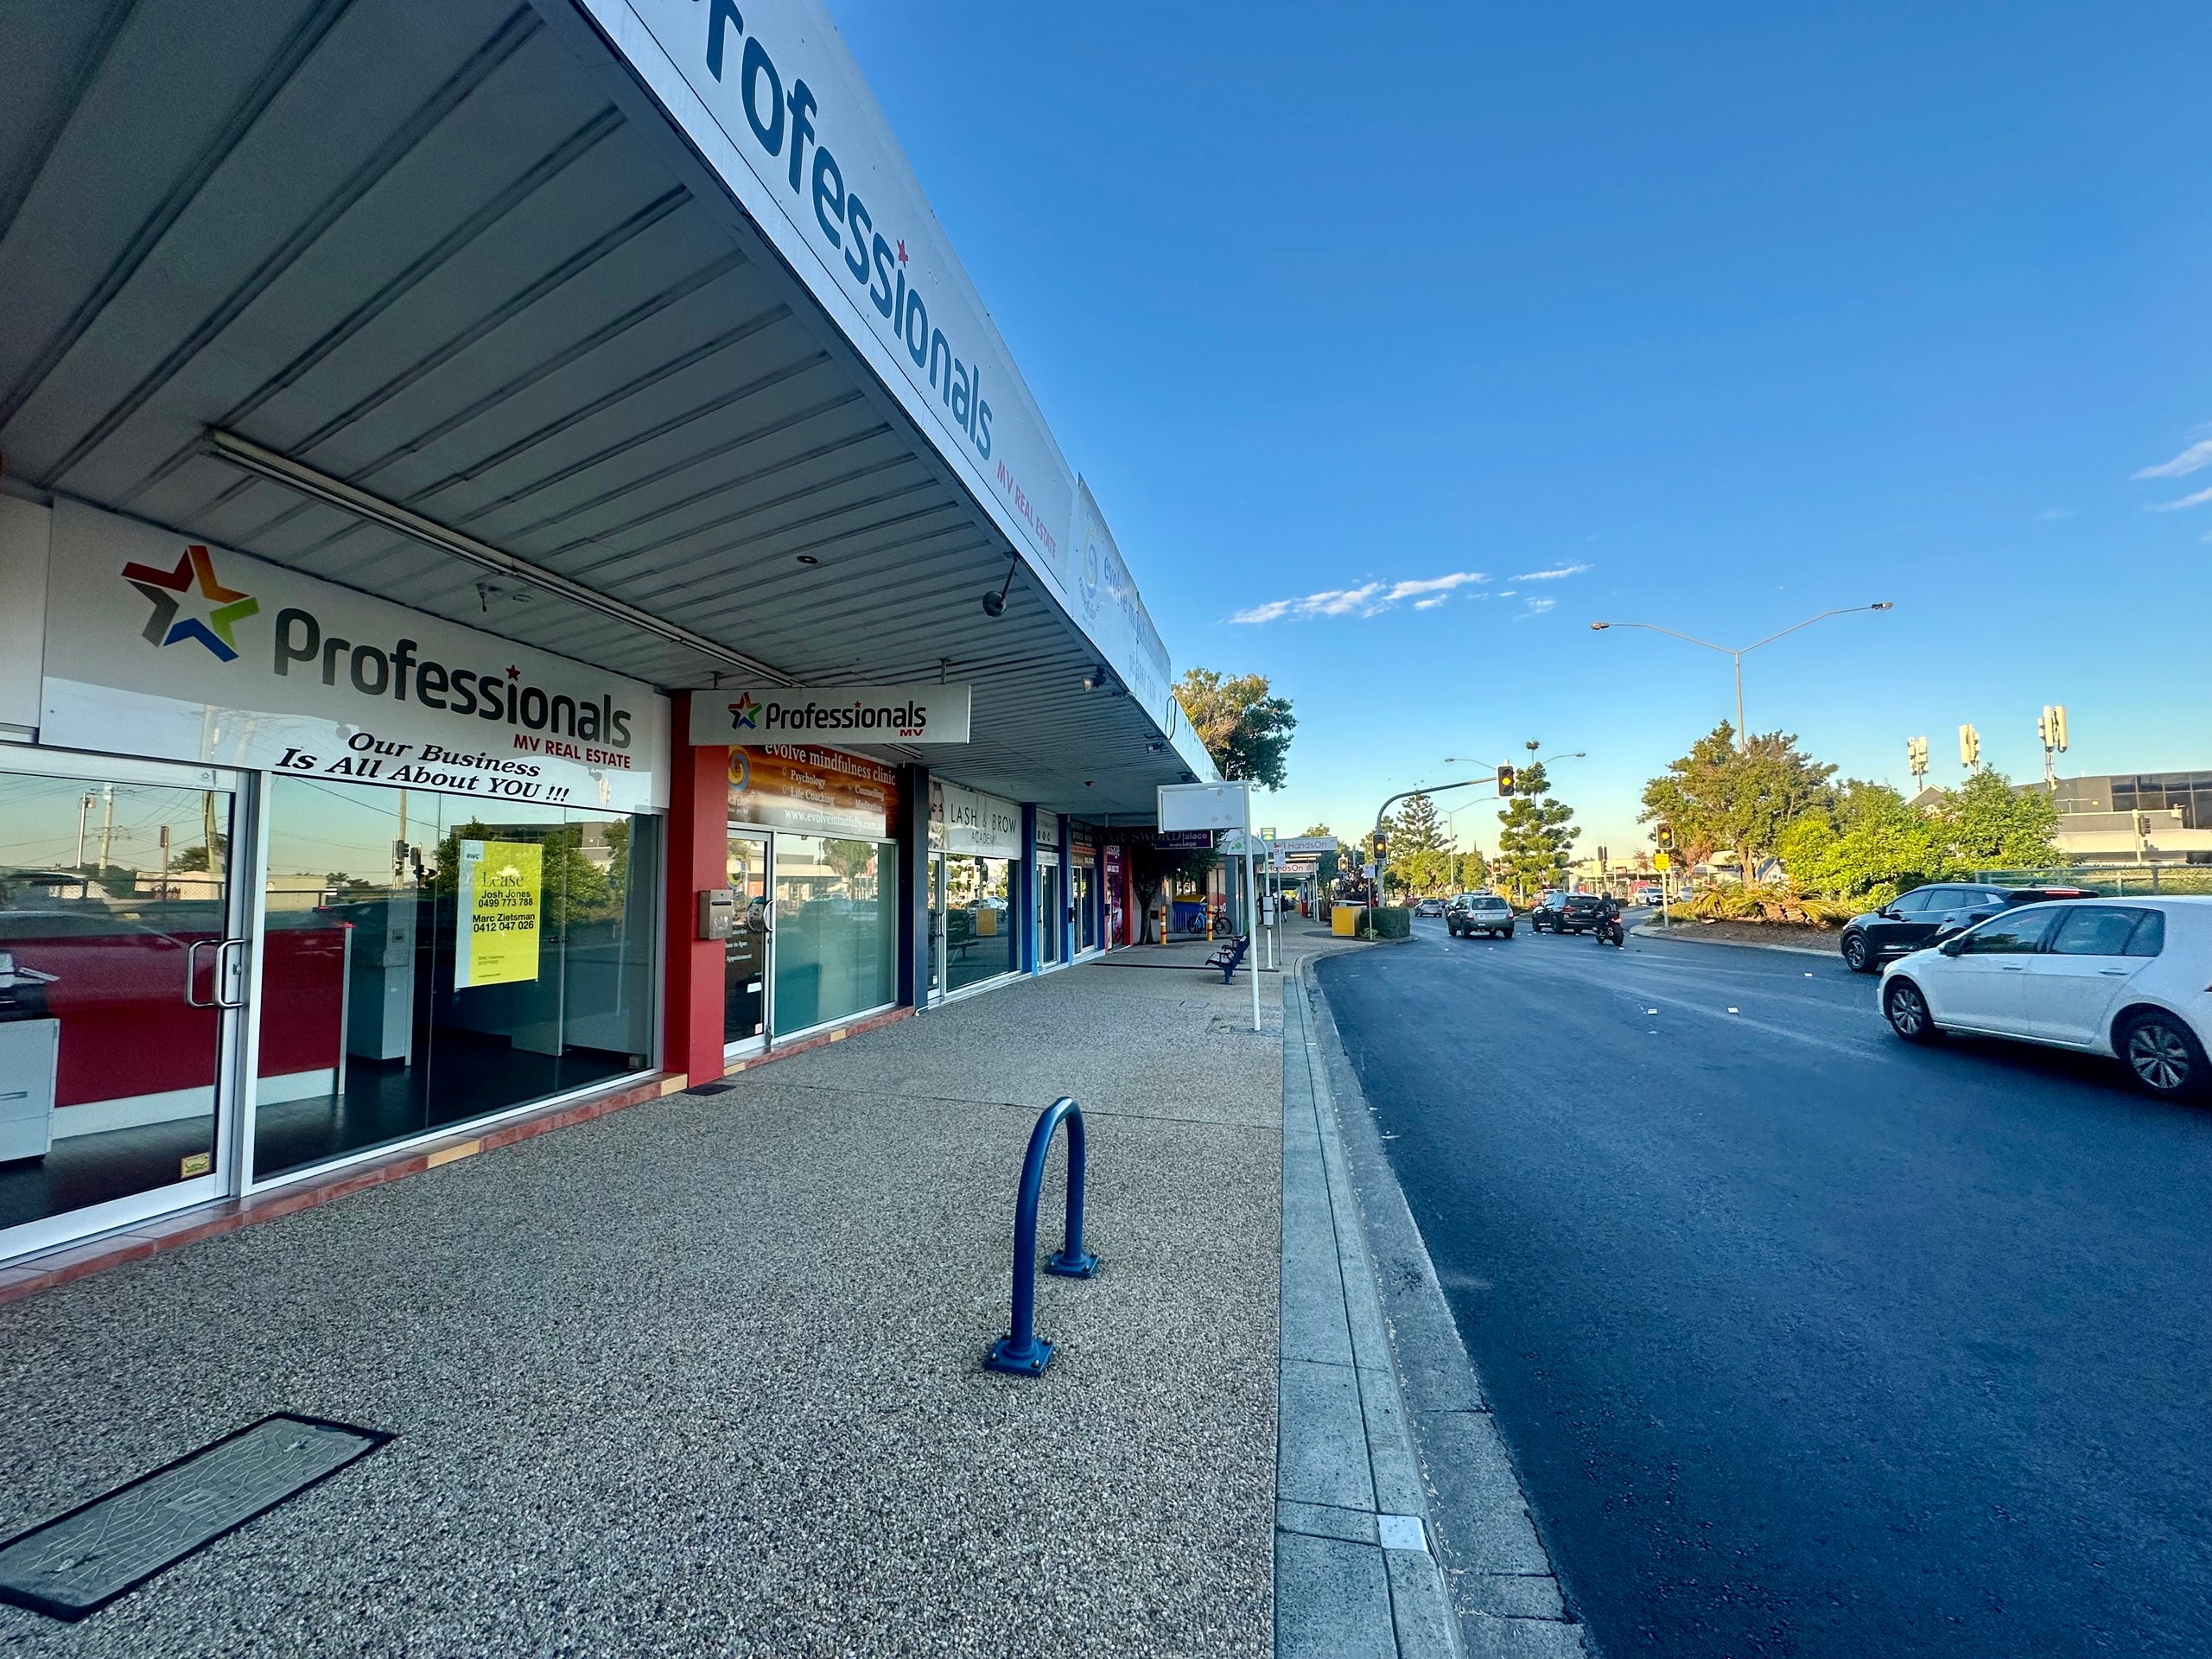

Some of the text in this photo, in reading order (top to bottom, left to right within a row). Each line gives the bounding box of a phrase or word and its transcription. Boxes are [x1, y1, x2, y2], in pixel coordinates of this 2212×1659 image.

[689, 0, 993, 461] rofessionals
[997, 459, 1057, 560] MV REAL ESTATE
[274, 607, 632, 749] Professionals
[766, 700, 927, 730] Professionals
[899, 728, 924, 737] MV
[347, 732, 541, 778] Our Business
[513, 734, 631, 769] MV REAL ESTATE
[276, 747, 317, 770] Is
[325, 755, 379, 779] All
[391, 765, 481, 791] About
[489, 777, 542, 798] YOU
[765, 744, 896, 785] evolve mindfulness clinic
[791, 769, 826, 790] Psychology
[790, 786, 836, 806] Life Coaching
[855, 784, 885, 801] Counselling
[855, 798, 883, 813] Meditation
[785, 809, 886, 831] www.evolvemindfully.com.au
[950, 804, 977, 827] LASH
[982, 811, 988, 828] &
[992, 814, 1017, 834] BROW
[971, 830, 998, 845] ACADEMY
[1288, 841, 1327, 849] HandsOn
[481, 871, 524, 887] Lease
[479, 898, 533, 907] 0499 773 788
[481, 889, 531, 899] Josh Jones
[473, 912, 536, 923] Marc Zietsman
[474, 920, 534, 932] 0412 047 026
